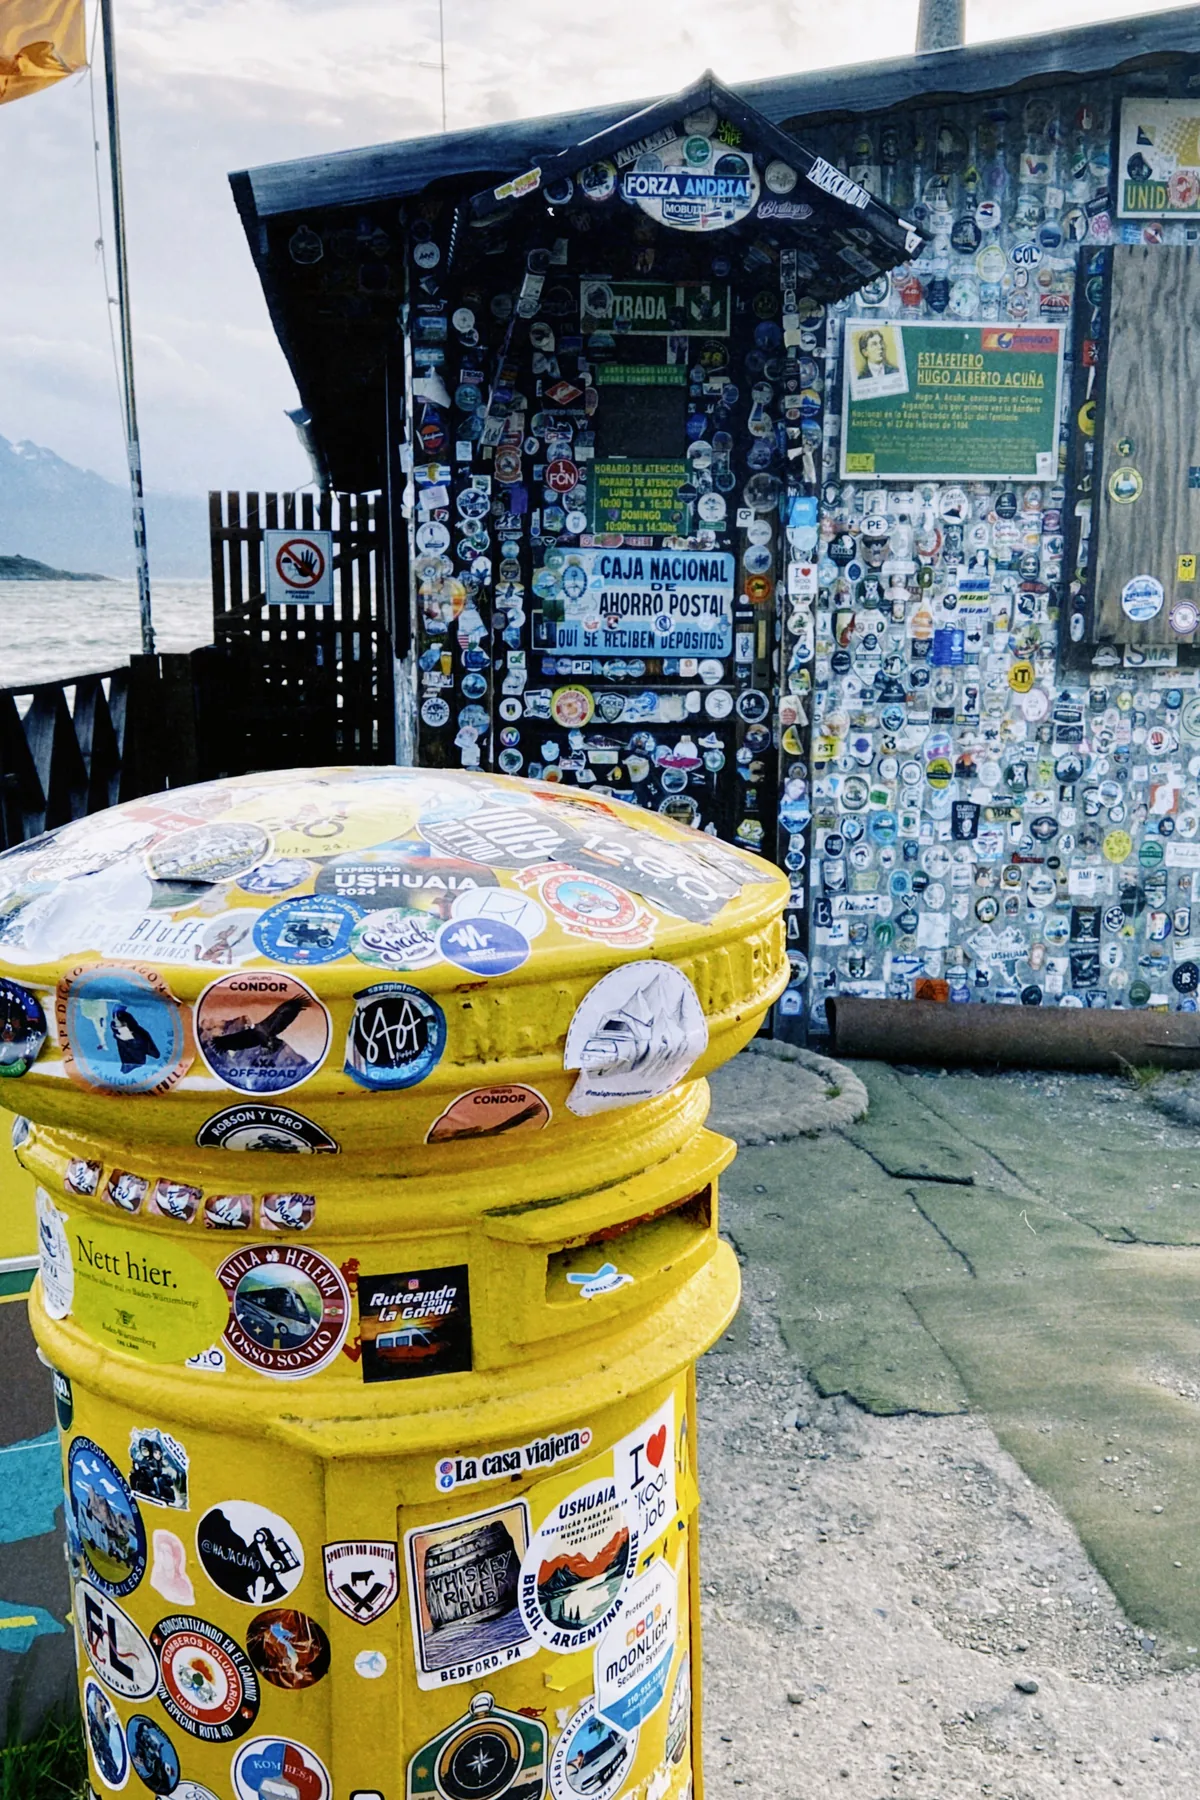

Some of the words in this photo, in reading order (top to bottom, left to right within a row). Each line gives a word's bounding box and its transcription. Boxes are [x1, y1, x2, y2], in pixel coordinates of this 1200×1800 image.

[627, 176, 679, 195] FORZA
[684, 177, 750, 197] ANDRIA!
[1012, 248, 1037, 263] COL
[598, 296, 667, 320] TRADA
[918, 353, 984, 367] ESTAFETERO
[917, 370, 951, 384] HUGO
[954, 371, 1001, 385] ALBERTO
[1004, 370, 1044, 386] ACUÑA
[550, 473, 574, 485] FCN
[594, 464, 631, 473] HORARIO
[632, 464, 643, 473] DE
[599, 477, 632, 486] HORARIO
[635, 478, 644, 486] DE
[609, 489, 634, 497] LUNES
[636, 489, 641, 497] A
[621, 511, 661, 520] DOMINGO
[868, 521, 882, 530] PE
[600, 556, 644, 580] CAJA
[650, 557, 728, 582] NACIONAL
[651, 582, 677, 591] DE
[599, 592, 663, 616] AHORRO
[669, 594, 726, 617] POSTAL
[558, 624, 578, 648] QUÍ
[583, 631, 599, 648] SE
[604, 631, 655, 649] RECIBEN
[334, 873, 479, 889] USHUAIA
[335, 865, 401, 874] EXPEDIÇÃO
[336, 887, 377, 896] 2024
[269, 898, 310, 919] MOTO
[312, 897, 362, 924] VIAJERO
[128, 918, 204, 945] Bluff
[361, 919, 436, 964] Shack
[111, 943, 148, 956] ESTATE
[154, 946, 190, 959] WINES
[260, 933, 310, 965] SANTIAGO
[990, 950, 1028, 960] USHUAIA
[229, 981, 288, 993] CONDOR
[228, 1067, 298, 1080] OFF-ROAD
[473, 1093, 526, 1105] CONDOR
[211, 1111, 258, 1137] ROBSON
[258, 1111, 267, 1121] Y
[268, 1112, 304, 1132] VERO
[77, 1235, 121, 1275] Nett
[125, 1251, 178, 1289] hier.
[220, 1251, 263, 1288] AVILA
[285, 1248, 340, 1297] HELENA
[370, 1284, 457, 1307] Ruteando
[421, 1299, 443, 1309] con
[378, 1308, 397, 1323] La
[401, 1301, 453, 1320] Gordi
[226, 1319, 275, 1367] VOSSO
[455, 1460, 477, 1482] La
[482, 1450, 522, 1477] casa
[525, 1433, 581, 1466] viajera
[630, 1443, 645, 1490] I
[559, 1484, 617, 1520] USHUAIA
[541, 1518, 582, 1537] EXPEDIÇÃO
[583, 1513, 601, 1524] PARA
[560, 1527, 586, 1541] MUNDO
[587, 1515, 614, 1532] AUSTRAL
[326, 1545, 354, 1564] SPORTIVO
[431, 1551, 513, 1595] WHISKEY
[444, 1571, 508, 1607] RIVER
[523, 1574, 544, 1632] BRASIL
[550, 1598, 624, 1648] ARGENTINA
[626, 1530, 640, 1579] CHILE
[460, 1591, 497, 1616] PUB
[625, 1591, 655, 1620] Protected
[84, 1591, 134, 1682] FL
[606, 1608, 673, 1684] MOONLIGHT
[158, 1616, 223, 1644] CONCIENTIZANDO
[222, 1638, 236, 1654] EN
[231, 1652, 244, 1668] EL
[239, 1665, 258, 1702] CAMINO
[507, 1647, 521, 1659] PA
[163, 1636, 203, 1664] BOMBEROS
[205, 1643, 239, 1713] VOLUNTARIOS
[617, 1659, 645, 1689] Security
[164, 1700, 197, 1734] ESPECIAL
[199, 1724, 221, 1740] RUTA
[221, 1724, 234, 1738] 40
[253, 1760, 281, 1771] KOM
[284, 1764, 314, 1784] BESA
